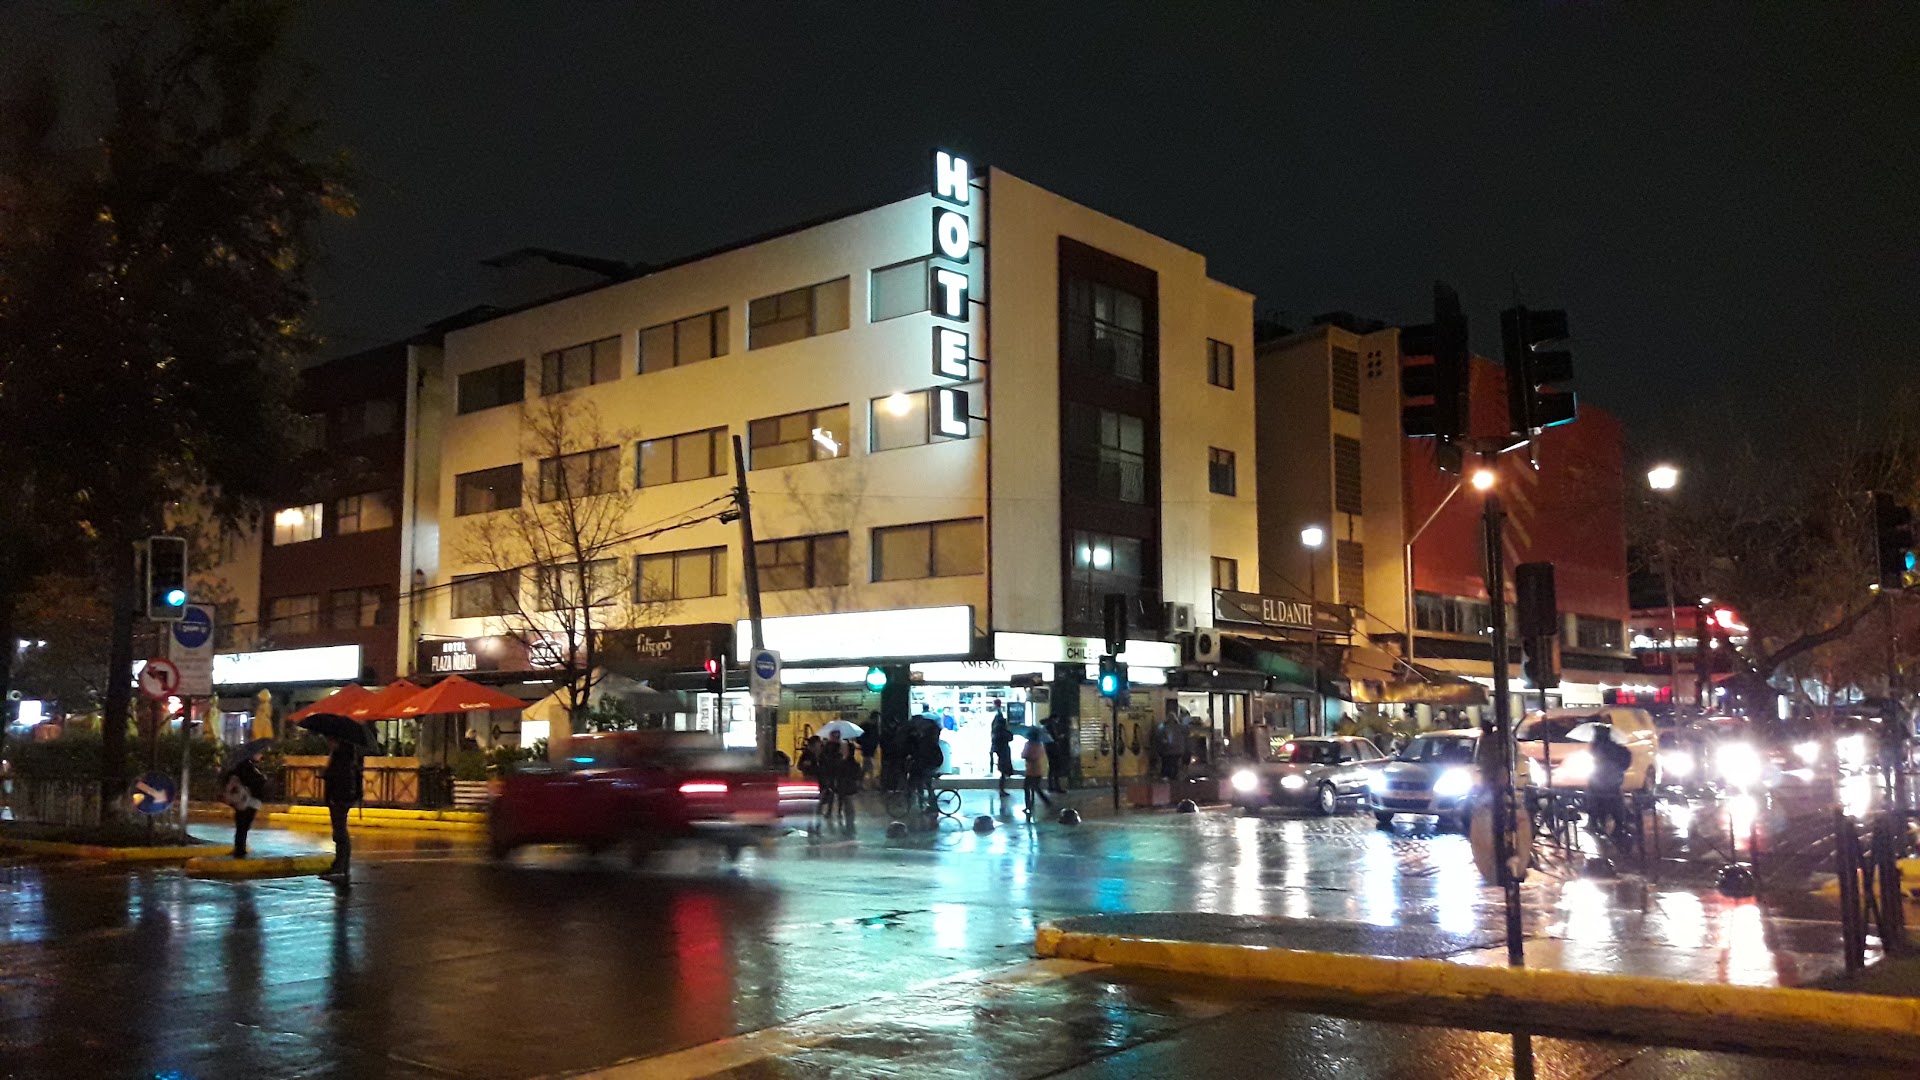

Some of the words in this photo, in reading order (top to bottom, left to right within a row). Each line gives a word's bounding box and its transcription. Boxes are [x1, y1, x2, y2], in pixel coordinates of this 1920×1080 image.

[936, 150, 969, 435] HOTEL
[1263, 599, 1278, 620] EL
[1279, 600, 1313, 625] DANTE
[443, 642, 466, 652] HOTEL
[432, 655, 452, 671] PLAZA
